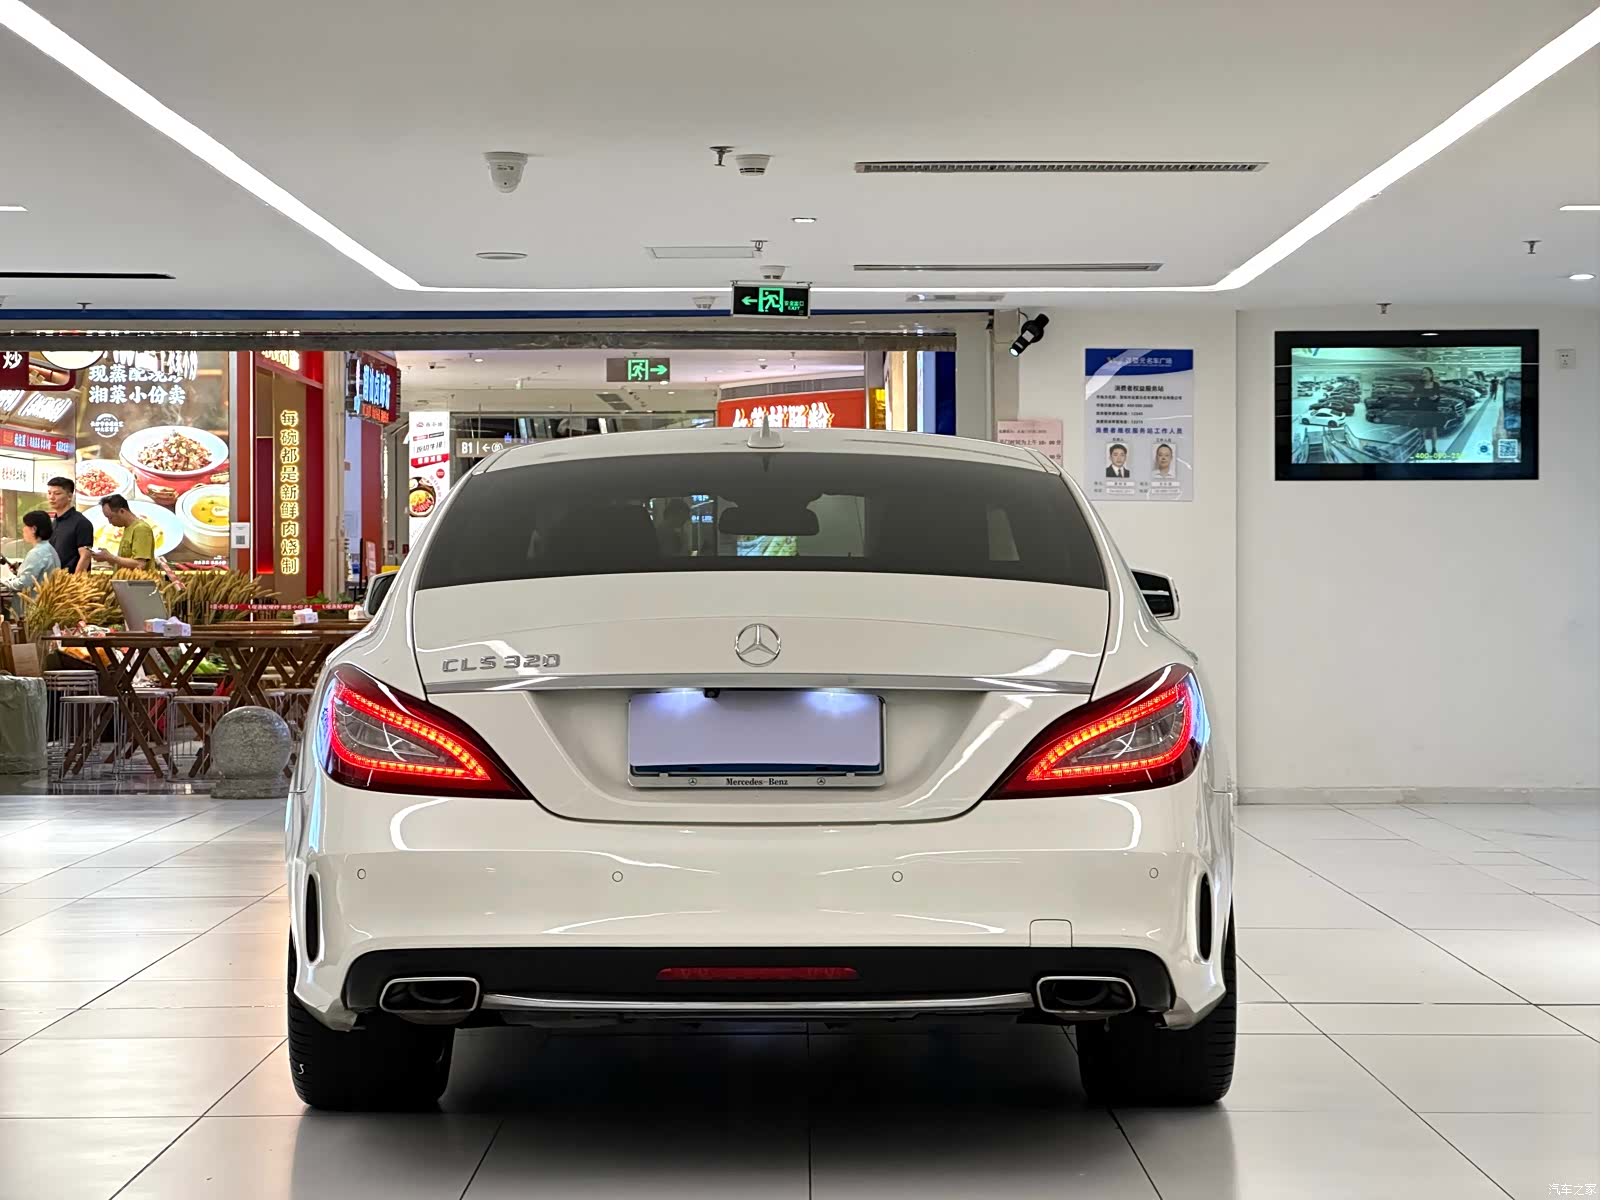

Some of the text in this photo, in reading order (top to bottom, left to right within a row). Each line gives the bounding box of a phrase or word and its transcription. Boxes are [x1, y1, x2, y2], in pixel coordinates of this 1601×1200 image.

[88, 384, 186, 405] 湘菜小份卖
[461, 441, 473, 454] B1
[280, 409, 300, 575] 每碗都是新鲜肉烧制
[442, 653, 560, 673] CLS 320
[726, 777, 789, 786] Mercedes-Benz
